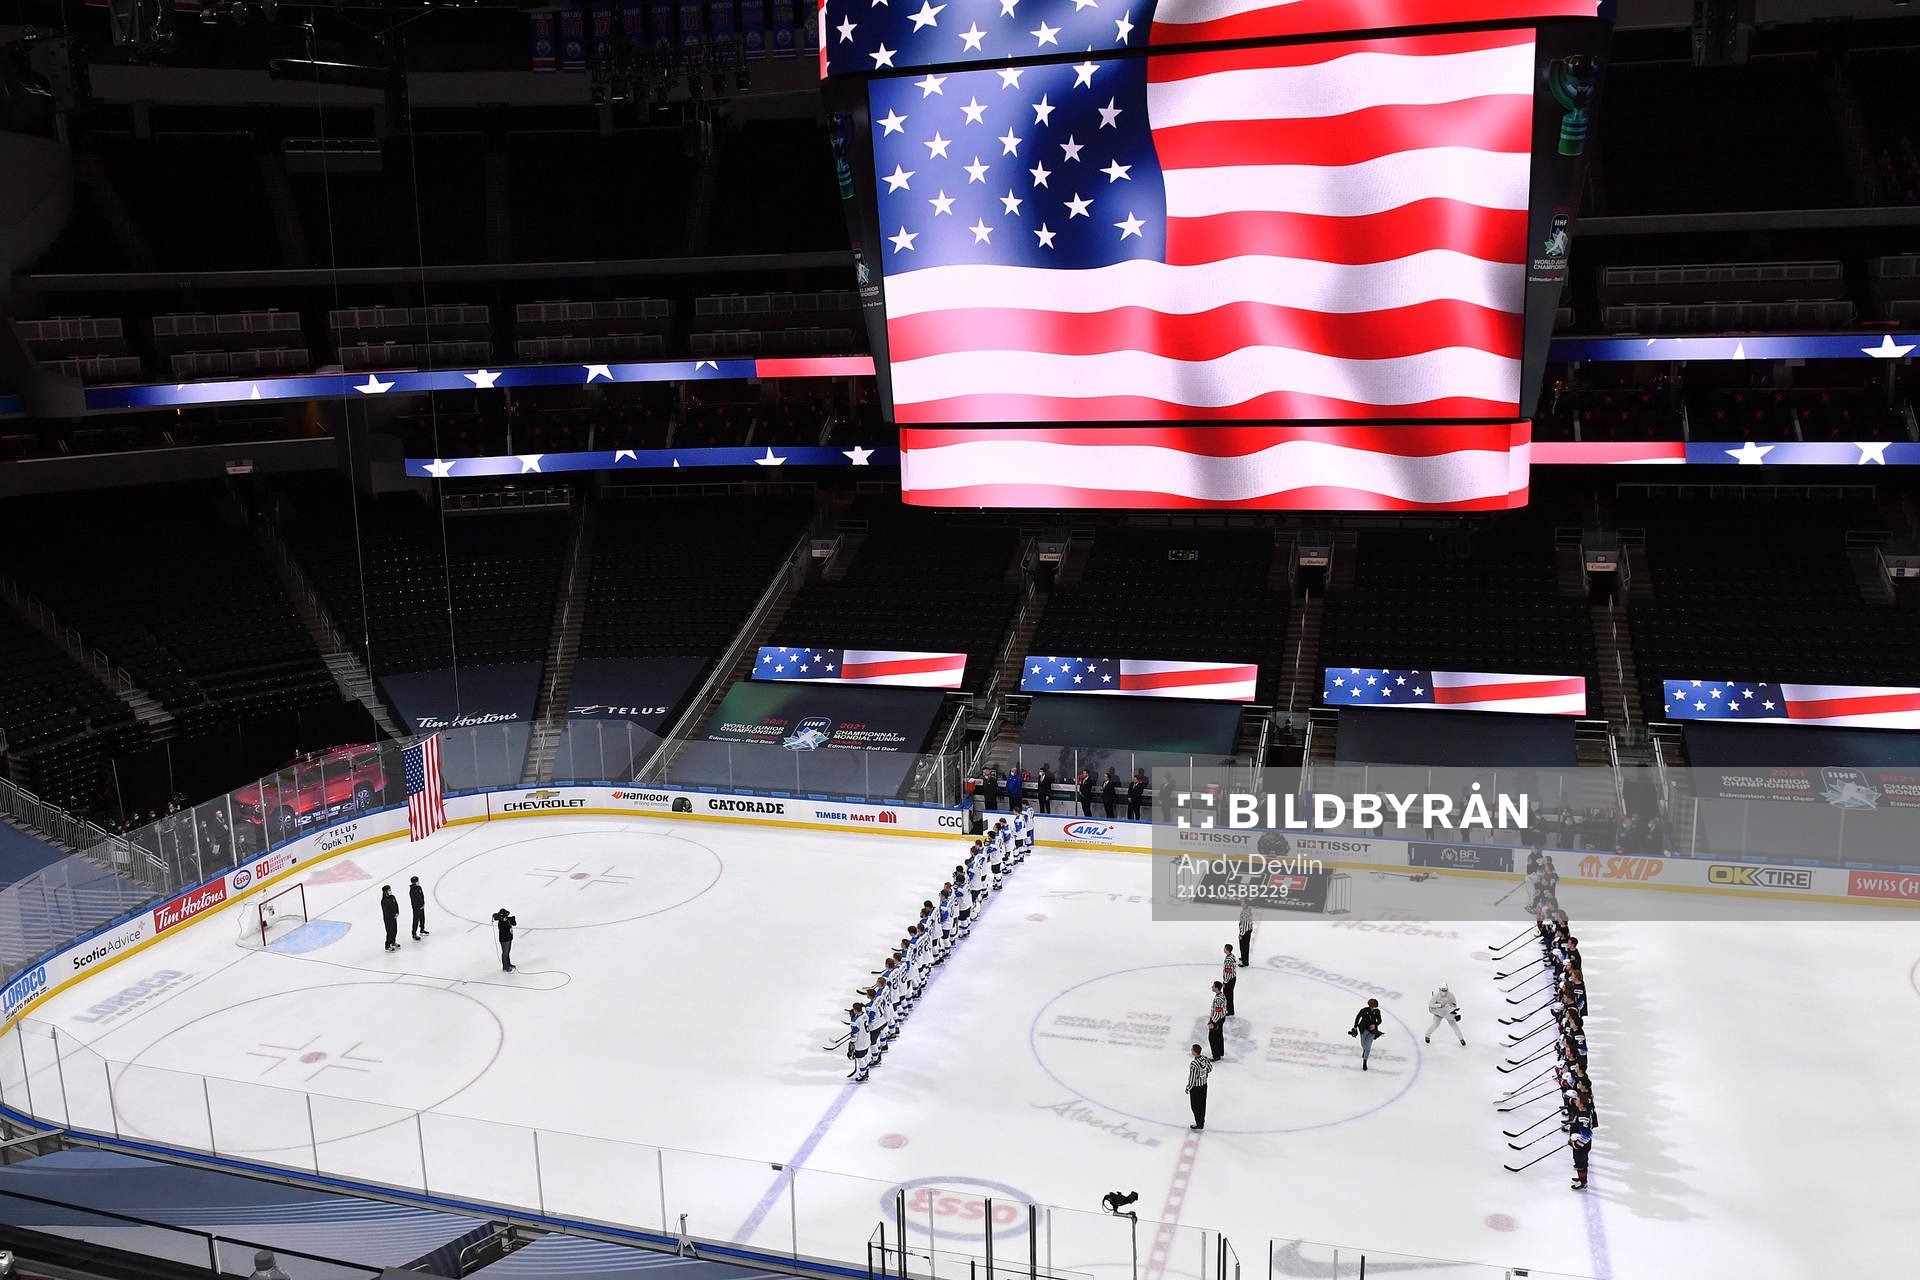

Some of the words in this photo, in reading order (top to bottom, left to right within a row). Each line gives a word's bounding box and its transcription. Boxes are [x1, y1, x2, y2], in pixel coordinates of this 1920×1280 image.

[607, 706, 667, 714] TELUS
[416, 716, 448, 728] Tim
[451, 711, 518, 728] Hortons
[723, 722, 752, 730] WORLD
[720, 726, 782, 736] CHAMPIONSHIP
[835, 730, 898, 738] CHAMPIONNAT
[708, 735, 741, 743] Edmonton
[1770, 768, 1807, 777] 2021
[1828, 771, 1858, 779] IIHF
[1880, 774, 1917, 783] 2021
[1721, 775, 1763, 783] WORLD
[1766, 777, 1809, 785] JUNIOR
[1723, 781, 1811, 790] CHAMPIONSHIP
[504, 799, 586, 812] CHEVROLET
[708, 799, 784, 815] GATORADE
[815, 811, 847, 821] TIMBER
[850, 814, 876, 823] MART
[329, 823, 358, 838] TELUS
[1072, 826, 1108, 836] AMJ
[321, 838, 342, 851] Optik
[344, 833, 355, 843] TV
[1200, 832, 1251, 844] TISSOT
[1318, 840, 1371, 853] TISSOT
[1460, 849, 1480, 860] BFL
[256, 861, 270, 879] 80
[1602, 856, 1665, 881] SKIP
[1708, 865, 1758, 886] OK
[1766, 871, 1808, 887] TIRE
[1856, 877, 1896, 892] SWISS
[156, 906, 179, 930] Tim
[180, 889, 224, 917] Hortons
[1266, 899, 1315, 907] TISSOT
[73, 929, 141, 970] ScotiaAdvice
[1267, 955, 1403, 1001] Edmonton
[2, 966, 47, 1013] LORDCO
[73, 969, 183, 1023] LORDCO
[10, 1003, 23, 1017] AUTO
[23, 991, 40, 1009] PARTS
[1031, 1100, 1146, 1146] Alberta
